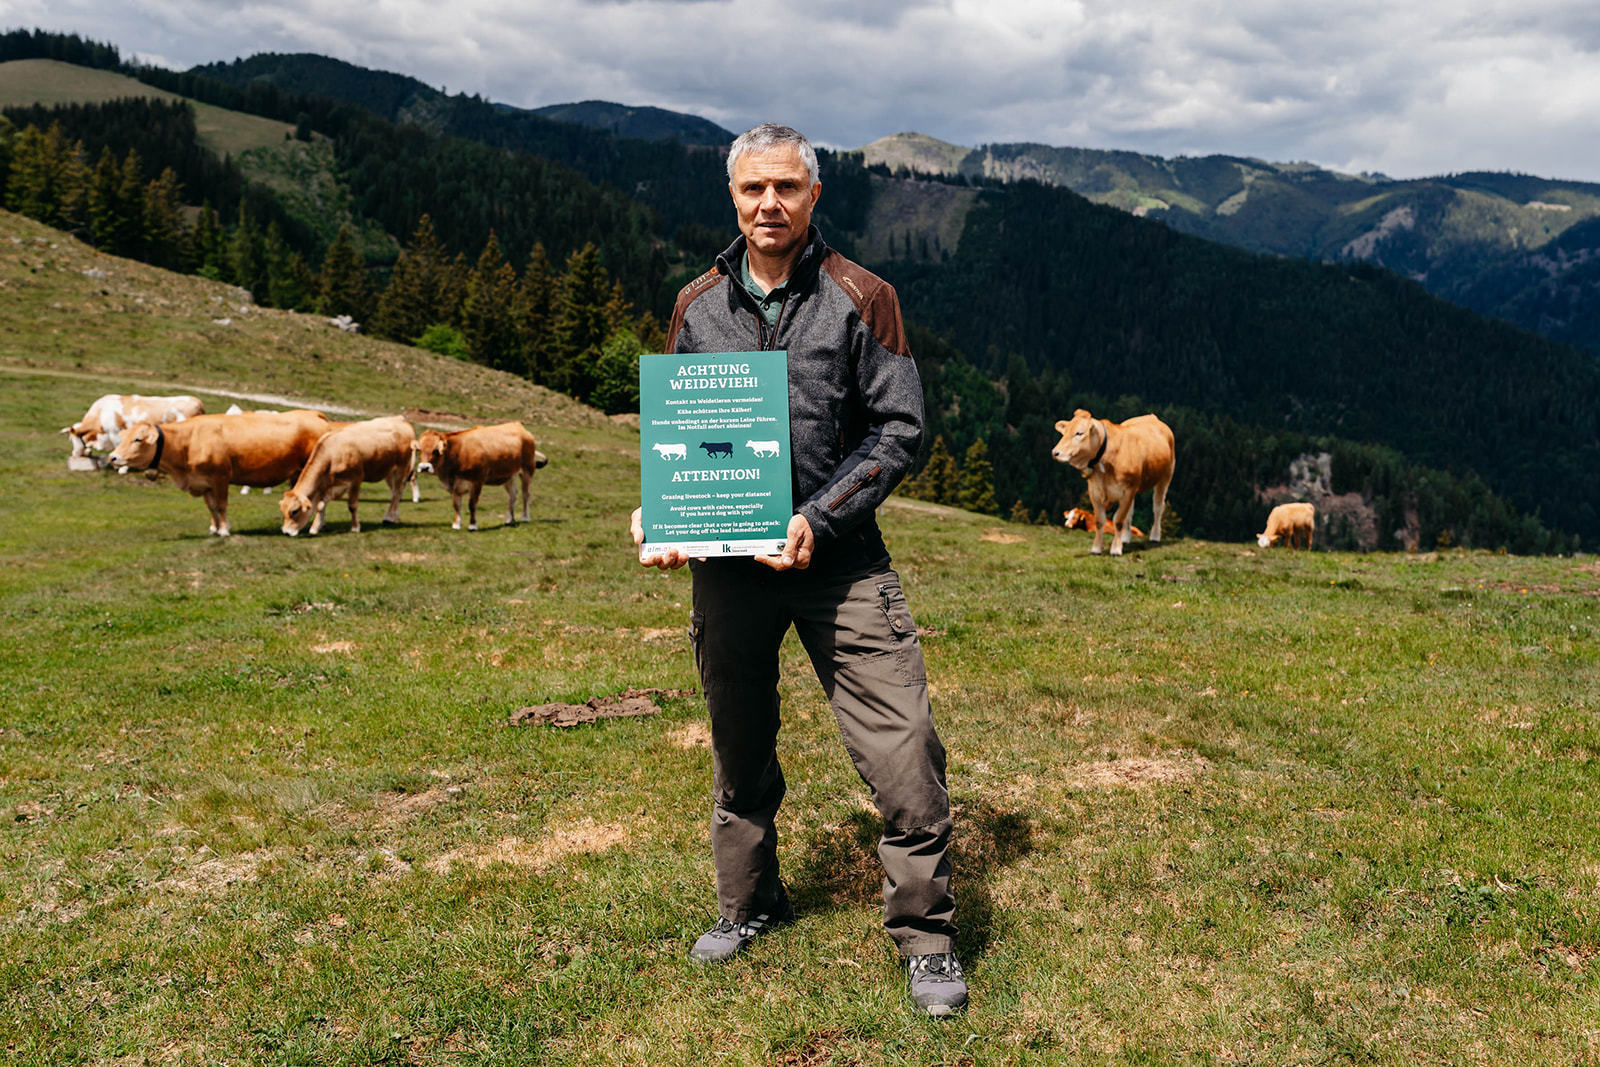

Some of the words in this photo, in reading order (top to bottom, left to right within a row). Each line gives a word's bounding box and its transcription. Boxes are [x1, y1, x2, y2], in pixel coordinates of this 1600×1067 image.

[677, 363, 750, 376] ACHTUNG
[670, 377, 758, 390] WEIDEVIEH!
[672, 468, 760, 482] ATTENTION!
